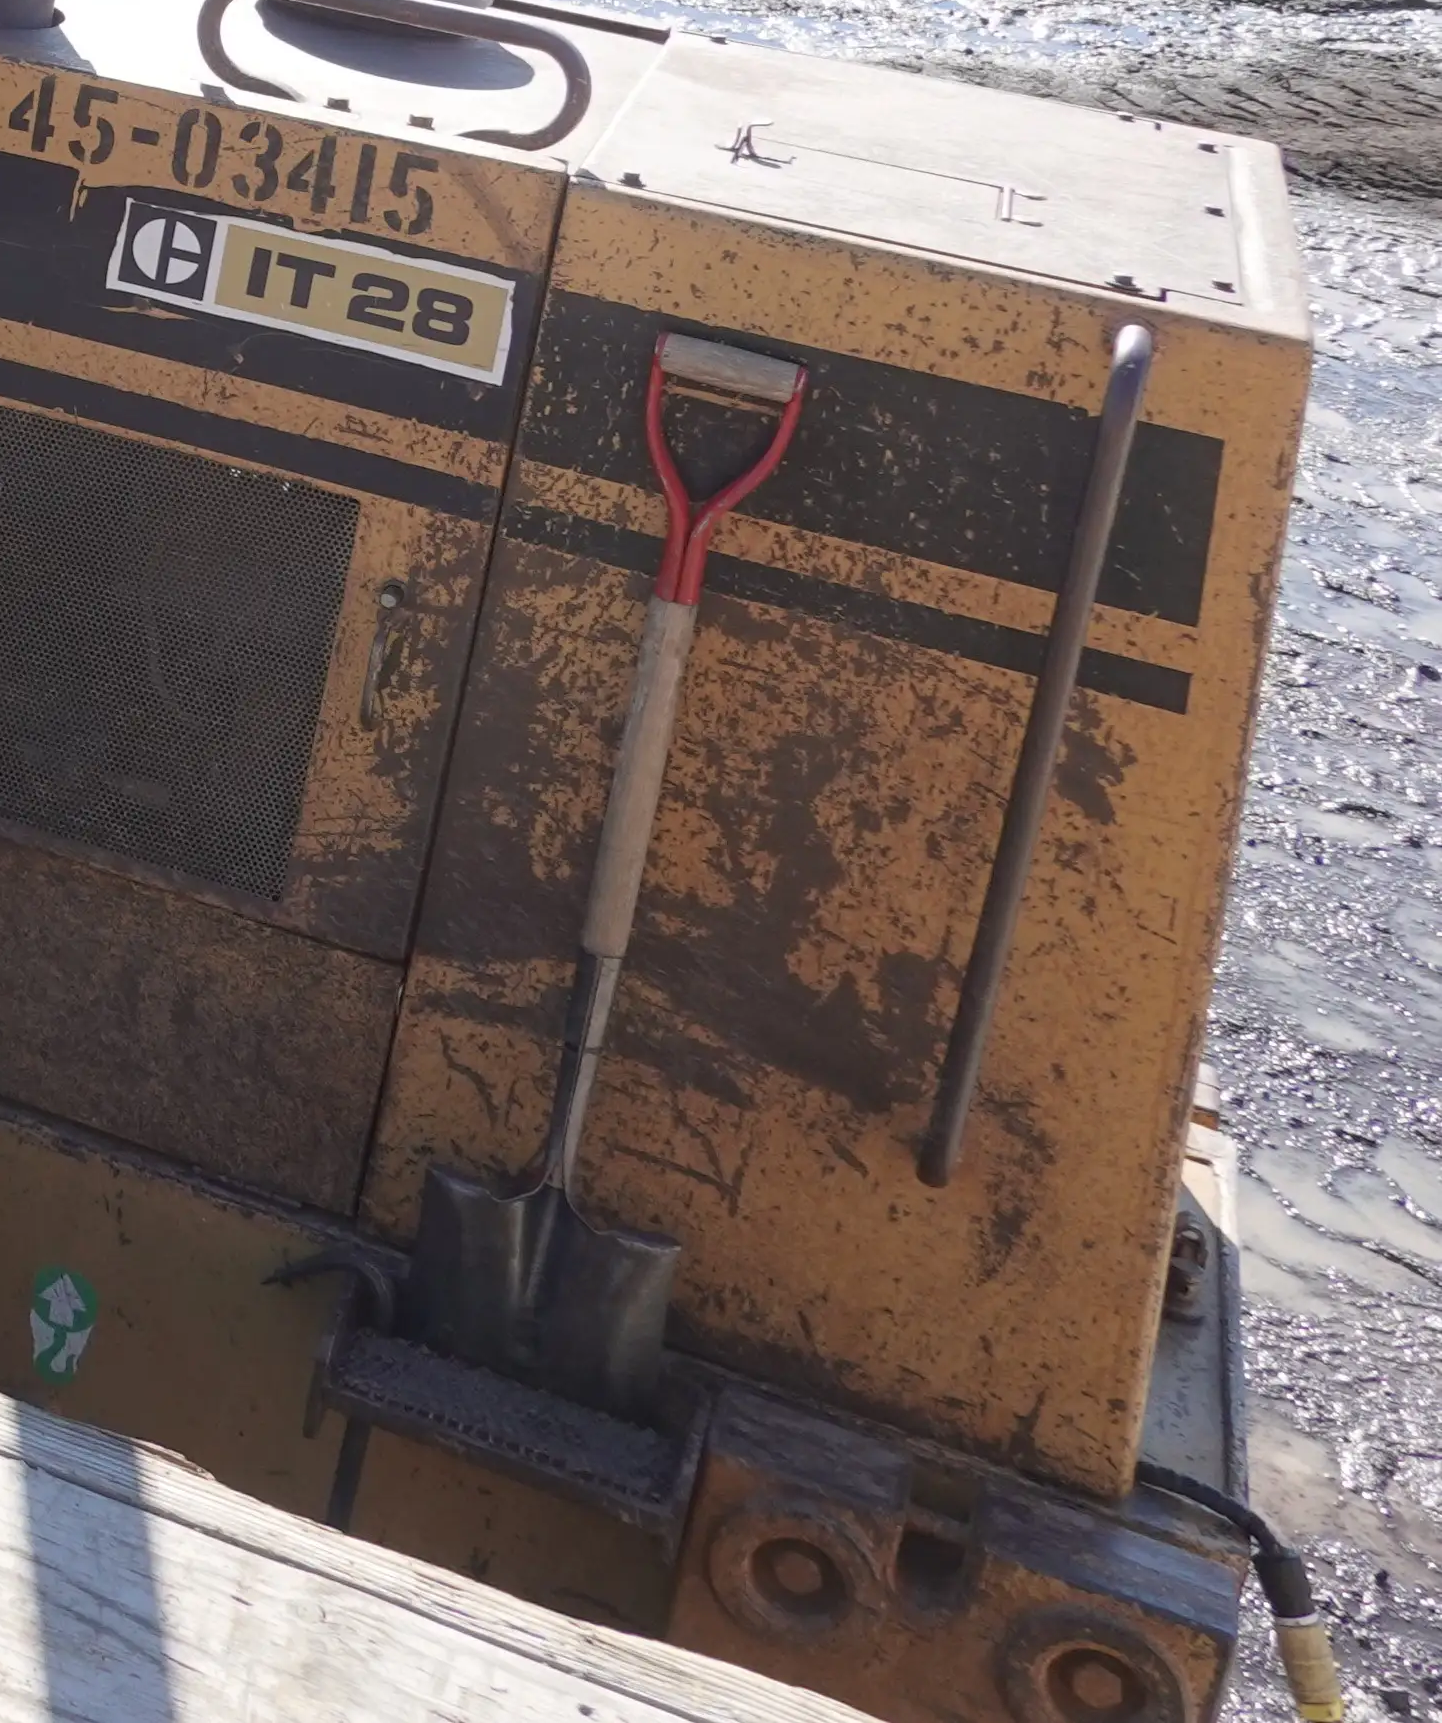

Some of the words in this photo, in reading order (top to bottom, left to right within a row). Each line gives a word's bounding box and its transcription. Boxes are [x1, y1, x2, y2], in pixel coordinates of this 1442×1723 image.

[8, 73, 439, 235] 45-03415
[246, 247, 335, 309] IT
[346, 271, 474, 346] 28
